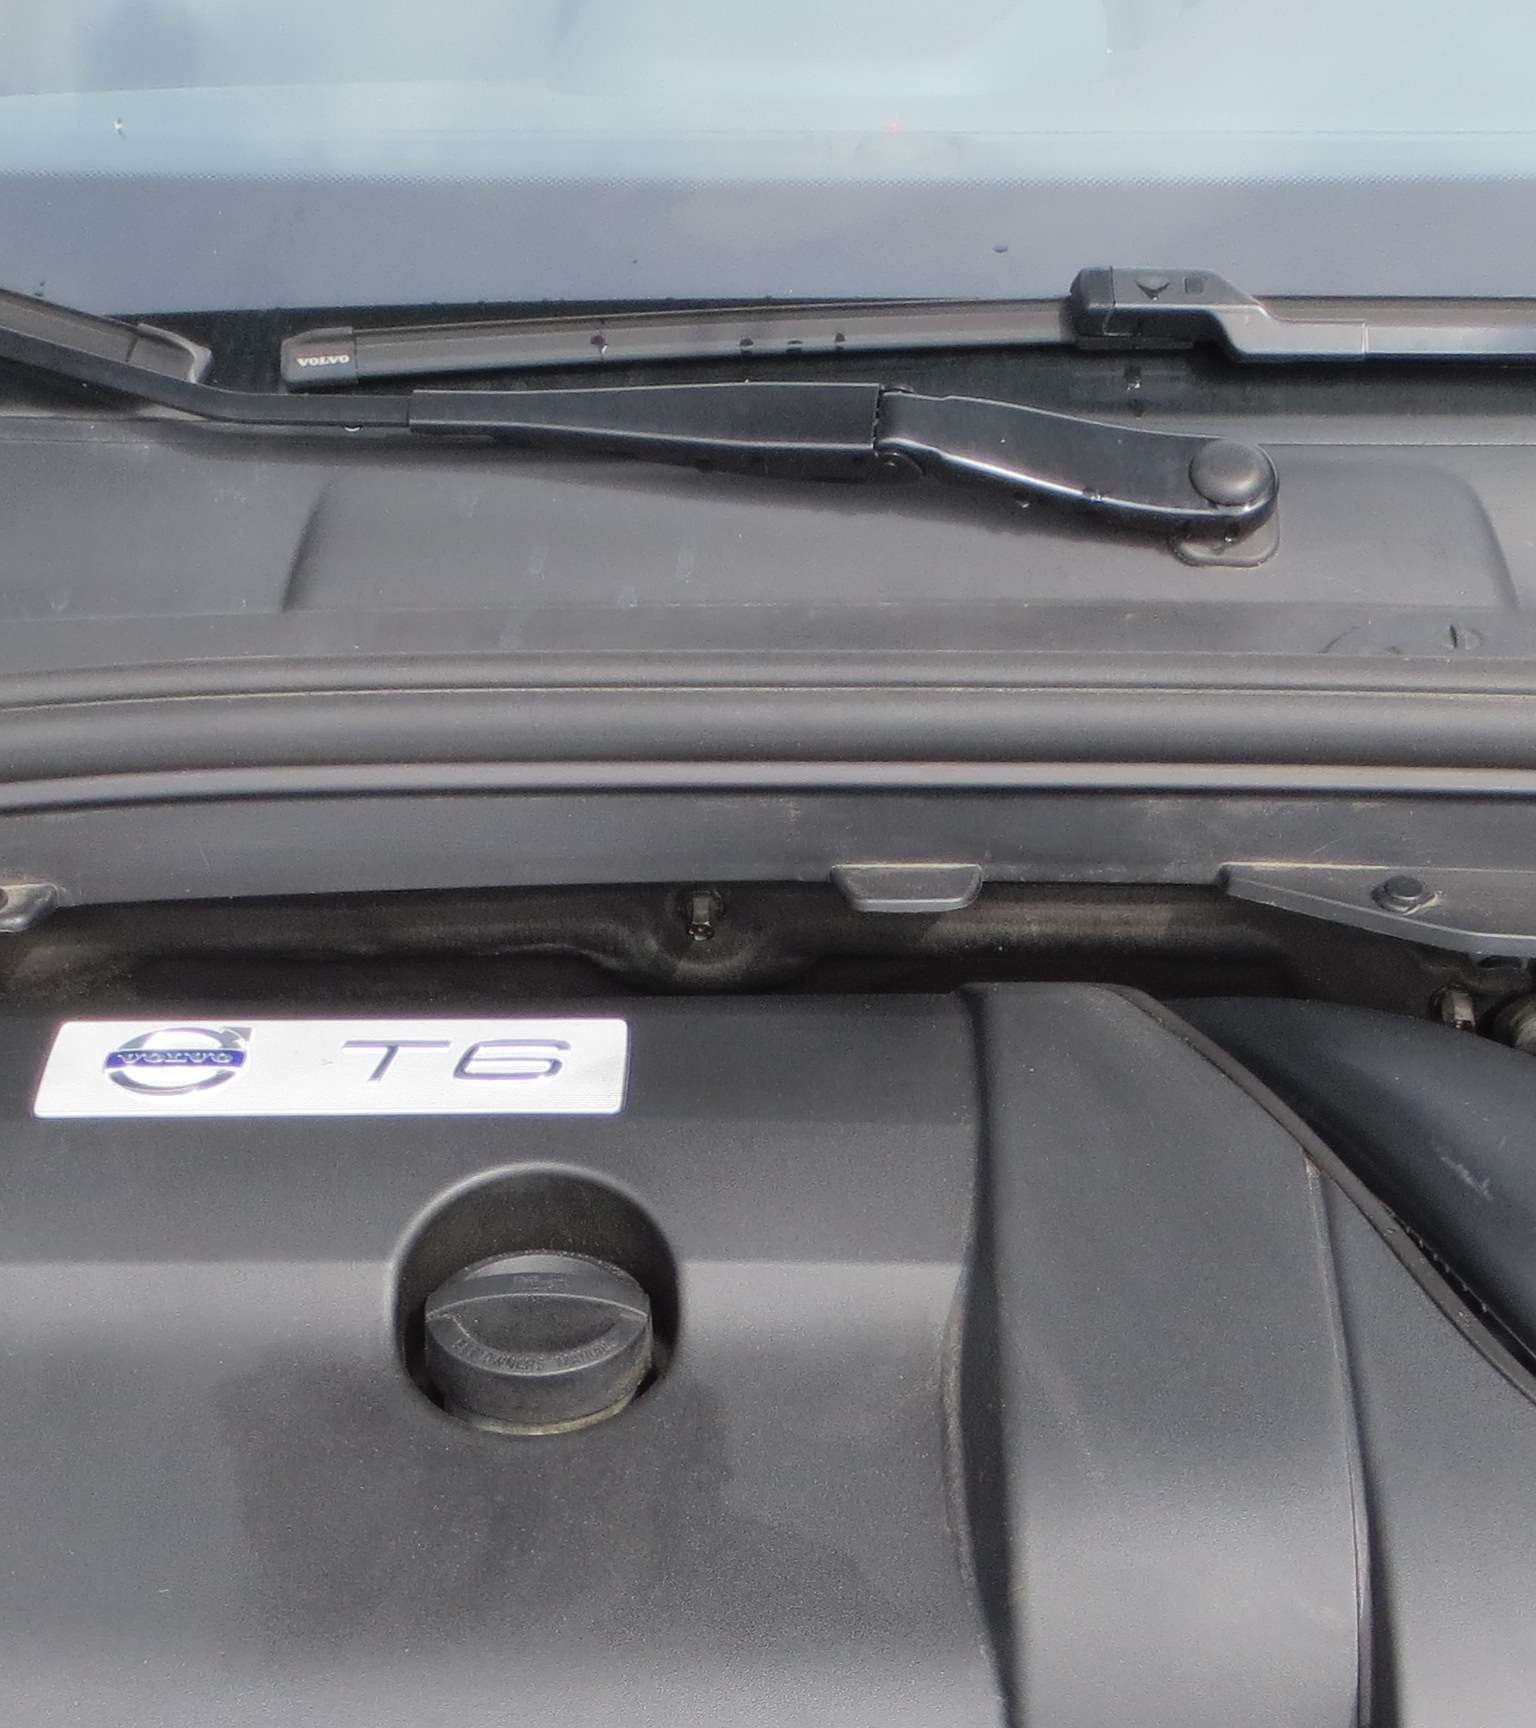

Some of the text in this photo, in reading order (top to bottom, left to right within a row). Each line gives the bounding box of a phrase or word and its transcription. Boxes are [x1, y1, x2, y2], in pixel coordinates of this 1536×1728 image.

[296, 355, 350, 367] VOLVO
[117, 1052, 233, 1064] VOLVO
[341, 1039, 572, 1082] T6
